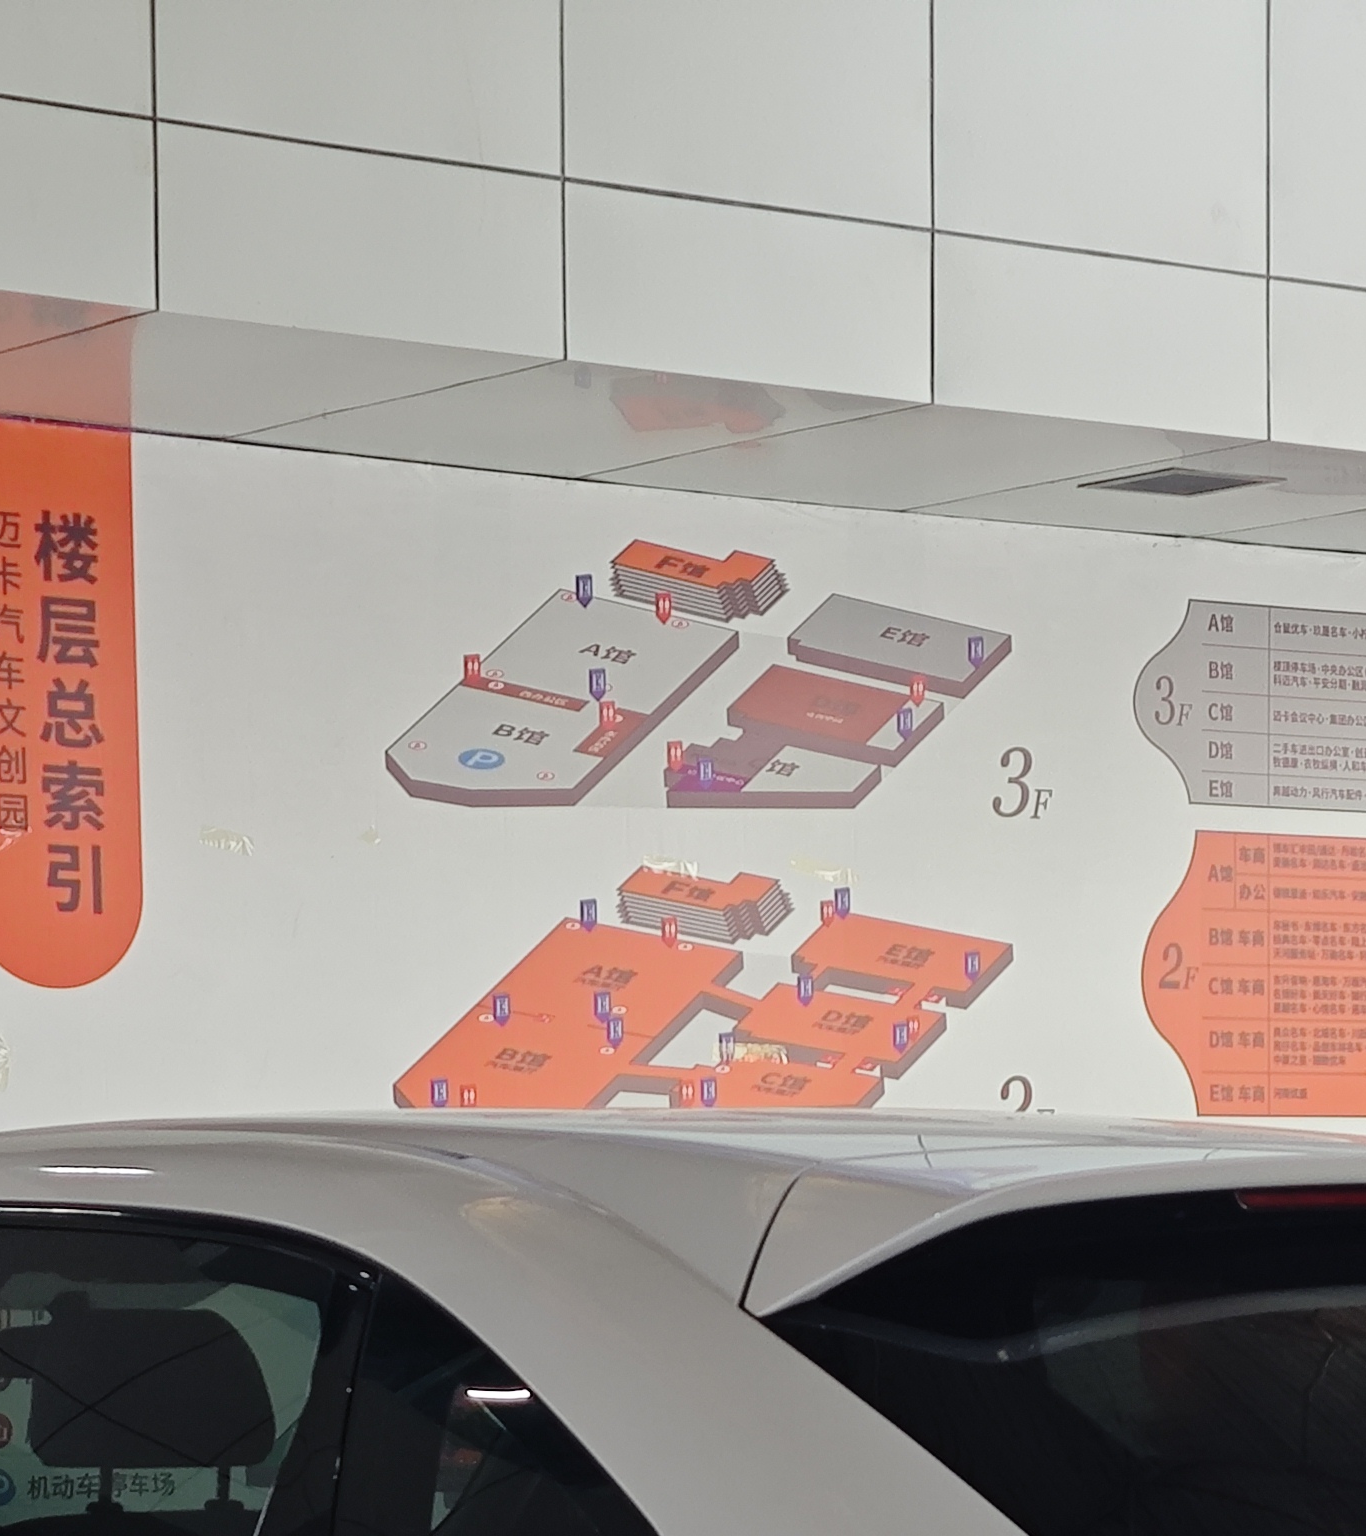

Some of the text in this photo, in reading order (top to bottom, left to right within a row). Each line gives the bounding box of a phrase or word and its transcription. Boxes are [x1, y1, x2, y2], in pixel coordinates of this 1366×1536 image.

[651, 553, 711, 579] F馆
[1207, 613, 1234, 633] A馆
[879, 625, 931, 648] E馆
[578, 641, 638, 667] A馆
[1207, 660, 1234, 681] B馆
[35, 508, 105, 916] 楼层总索引
[1153, 675, 1194, 727] 3F
[1207, 702, 1234, 722] C馆
[490, 722, 551, 746] B馆
[1207, 741, 1234, 761] D馆
[992, 746, 1053, 820] 3F
[1207, 779, 1234, 799] E馆
[1207, 864, 1234, 883] A馆
[658, 878, 716, 902] F馆
[1238, 883, 1266, 902] 办公
[1207, 927, 1234, 947] B馆
[884, 942, 936, 966] E馆
[580, 964, 639, 988] A馆
[1158, 942, 1199, 991] 2F
[1207, 977, 1234, 996] C馆
[820, 1008, 874, 1031] D馆
[1207, 1029, 1234, 1050] D馆
[493, 1046, 554, 1070] B馆
[758, 1070, 813, 1093] C馆
[1207, 1083, 1234, 1104] E馆
